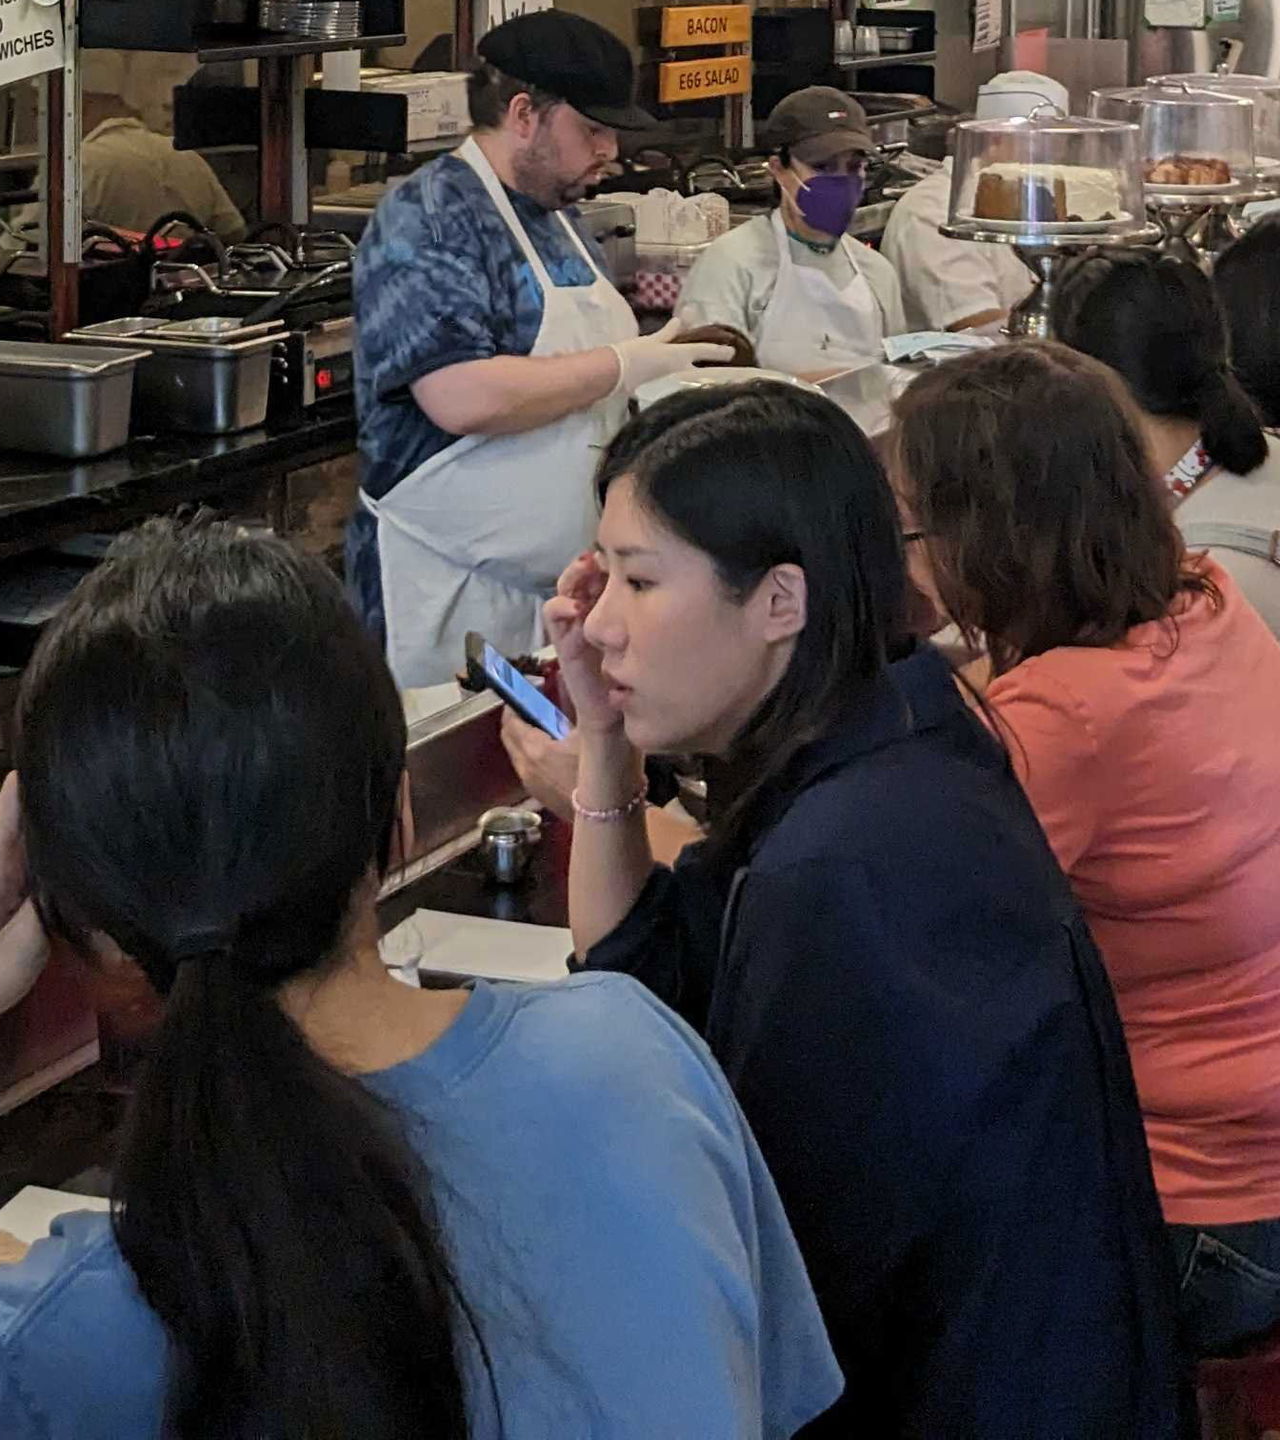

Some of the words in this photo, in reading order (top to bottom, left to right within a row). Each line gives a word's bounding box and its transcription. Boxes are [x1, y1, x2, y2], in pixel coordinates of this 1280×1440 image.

[687, 17, 728, 35] BACON
[679, 71, 702, 90] EGG
[705, 67, 739, 87] SALAD
